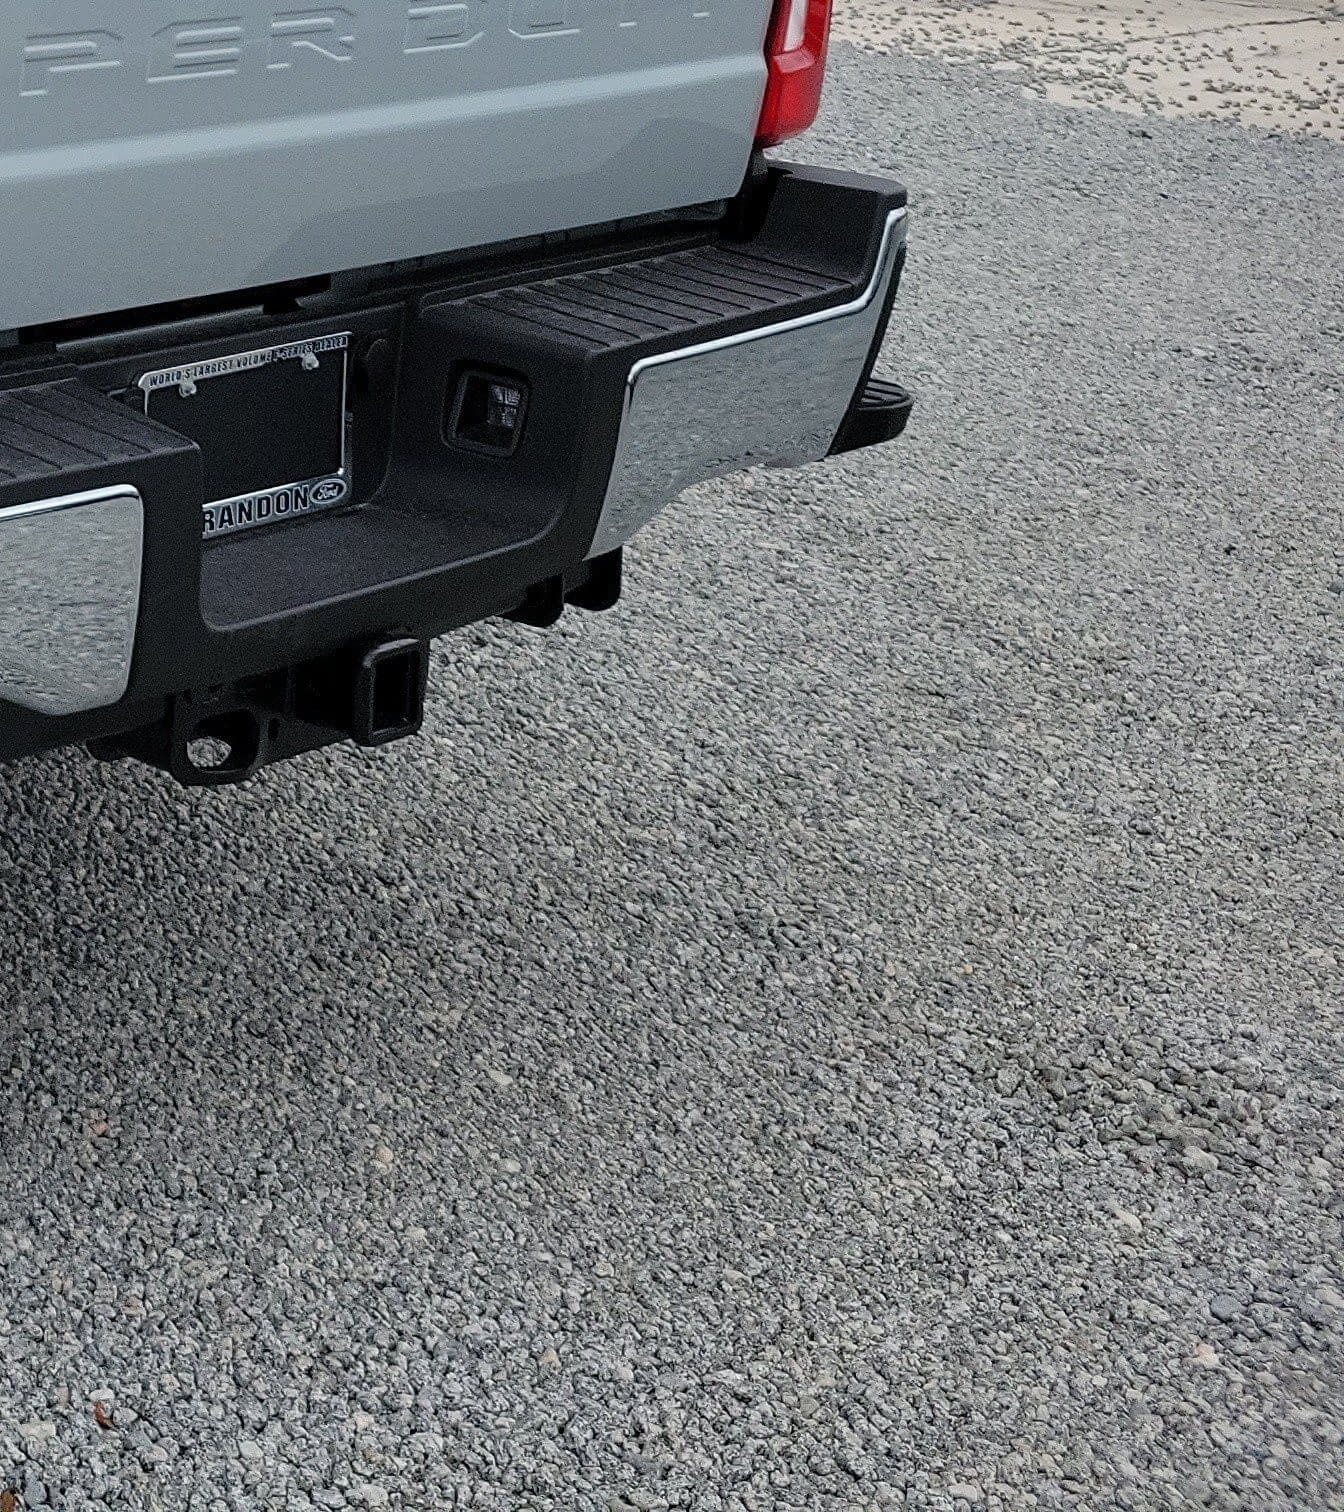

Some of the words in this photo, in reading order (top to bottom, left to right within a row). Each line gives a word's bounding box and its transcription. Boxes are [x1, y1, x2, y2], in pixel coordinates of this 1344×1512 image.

[150, 370, 190, 386] WORLD'S
[194, 360, 233, 376] LARGEST
[236, 351, 272, 367] VOLUME
[203, 485, 309, 531] RANDON
[317, 484, 339, 500] Ford
